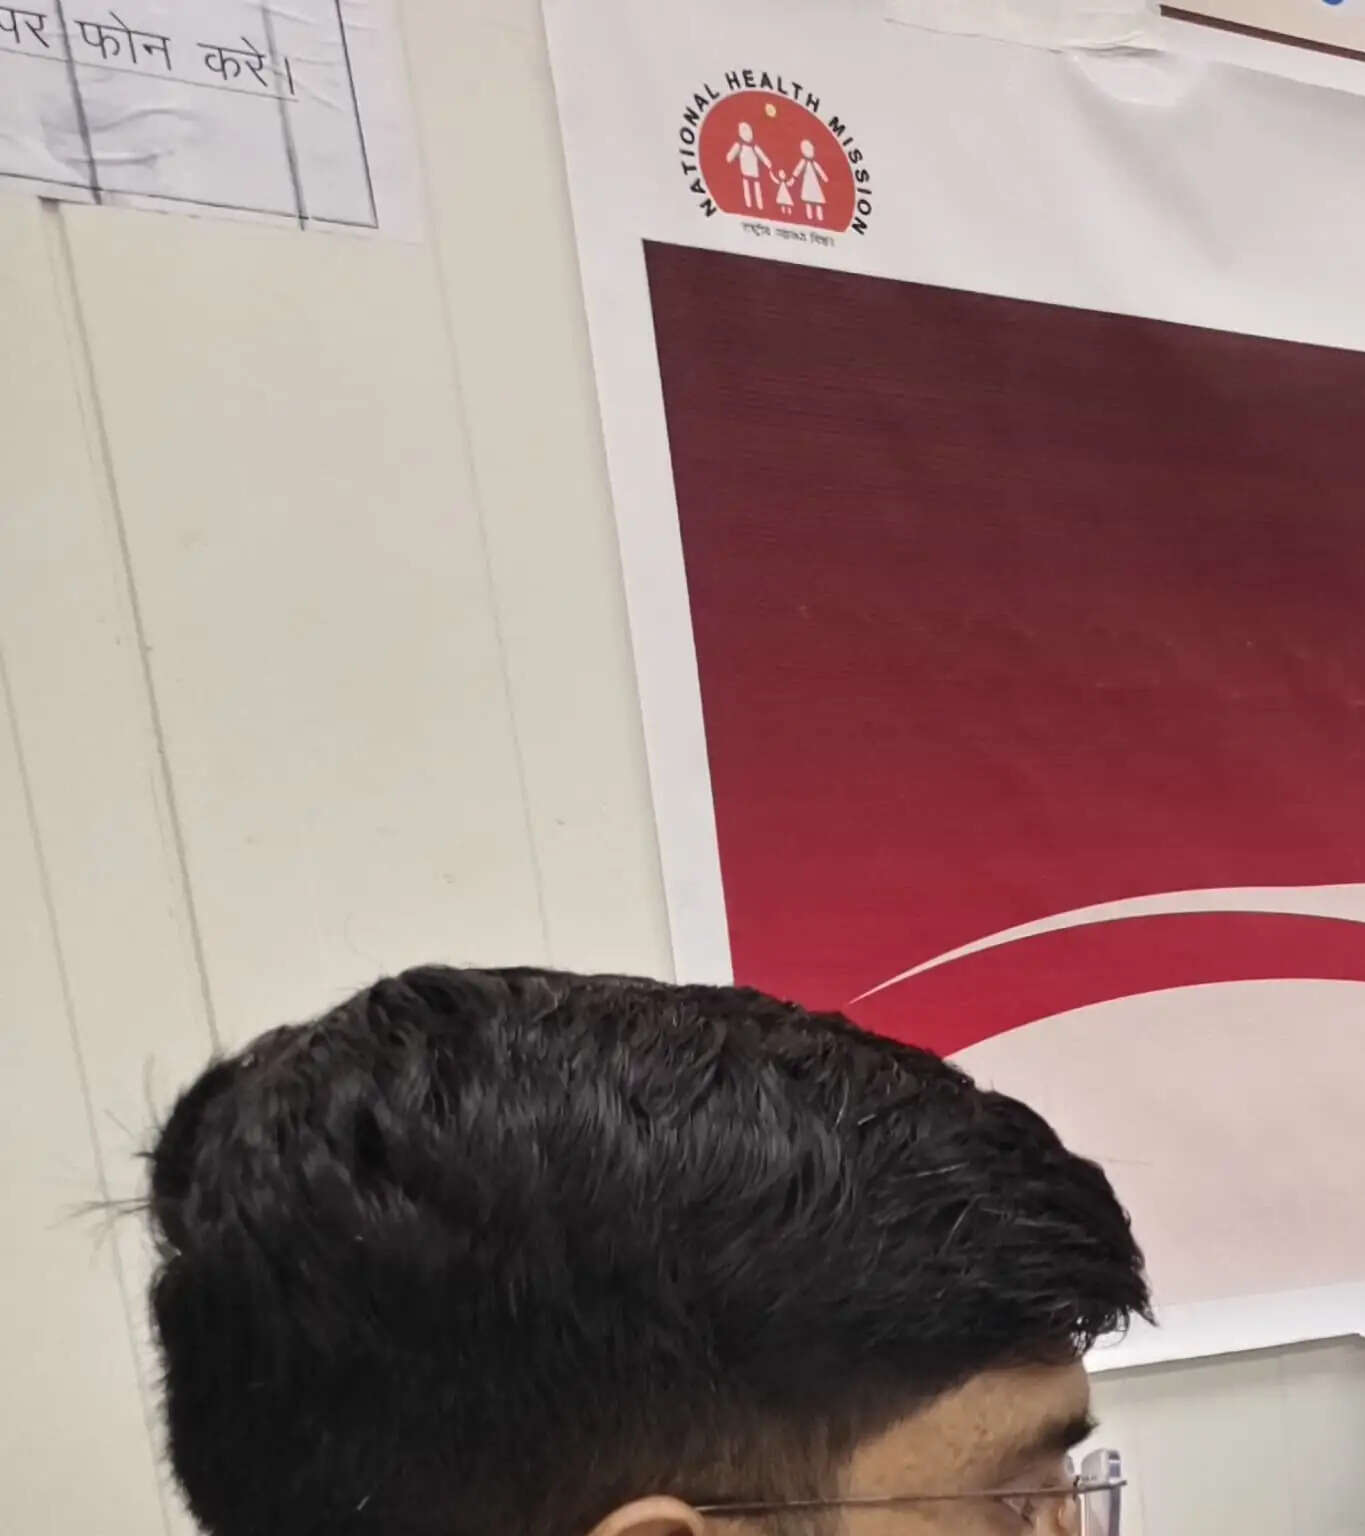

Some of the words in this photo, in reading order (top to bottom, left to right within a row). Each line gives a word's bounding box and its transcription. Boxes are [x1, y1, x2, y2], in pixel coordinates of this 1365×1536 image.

[75, 12, 171, 71] फोन
[679, 84, 720, 217] NATIONAL
[725, 70, 821, 112] HEALTH
[828, 116, 872, 235] MISSION
